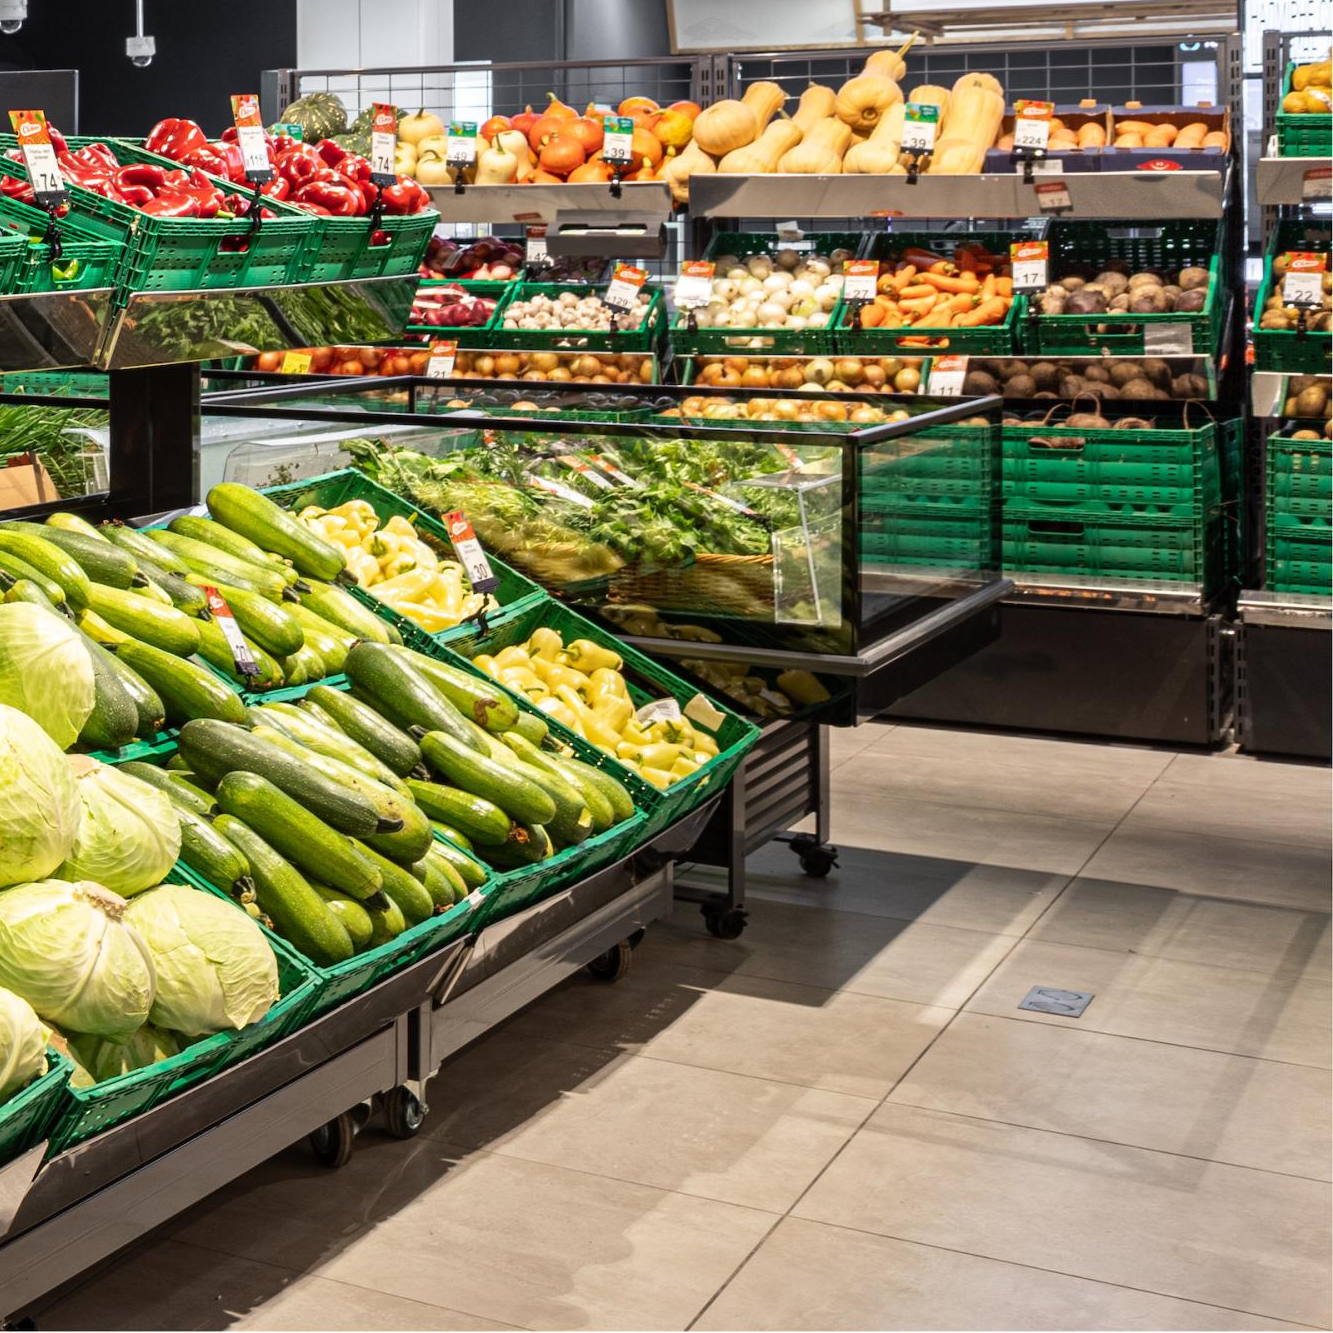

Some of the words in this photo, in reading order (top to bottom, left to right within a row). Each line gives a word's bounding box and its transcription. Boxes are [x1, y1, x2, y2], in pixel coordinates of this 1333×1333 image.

[910, 137, 926, 148] 39
[1022, 136, 1042, 145] 224
[611, 147, 625, 158] 39
[378, 156, 390, 170] 74
[40, 173, 58, 191] 74
[1023, 273, 1039, 284] 17
[1294, 291, 1314, 302] 22
[473, 563, 488, 579] 30
